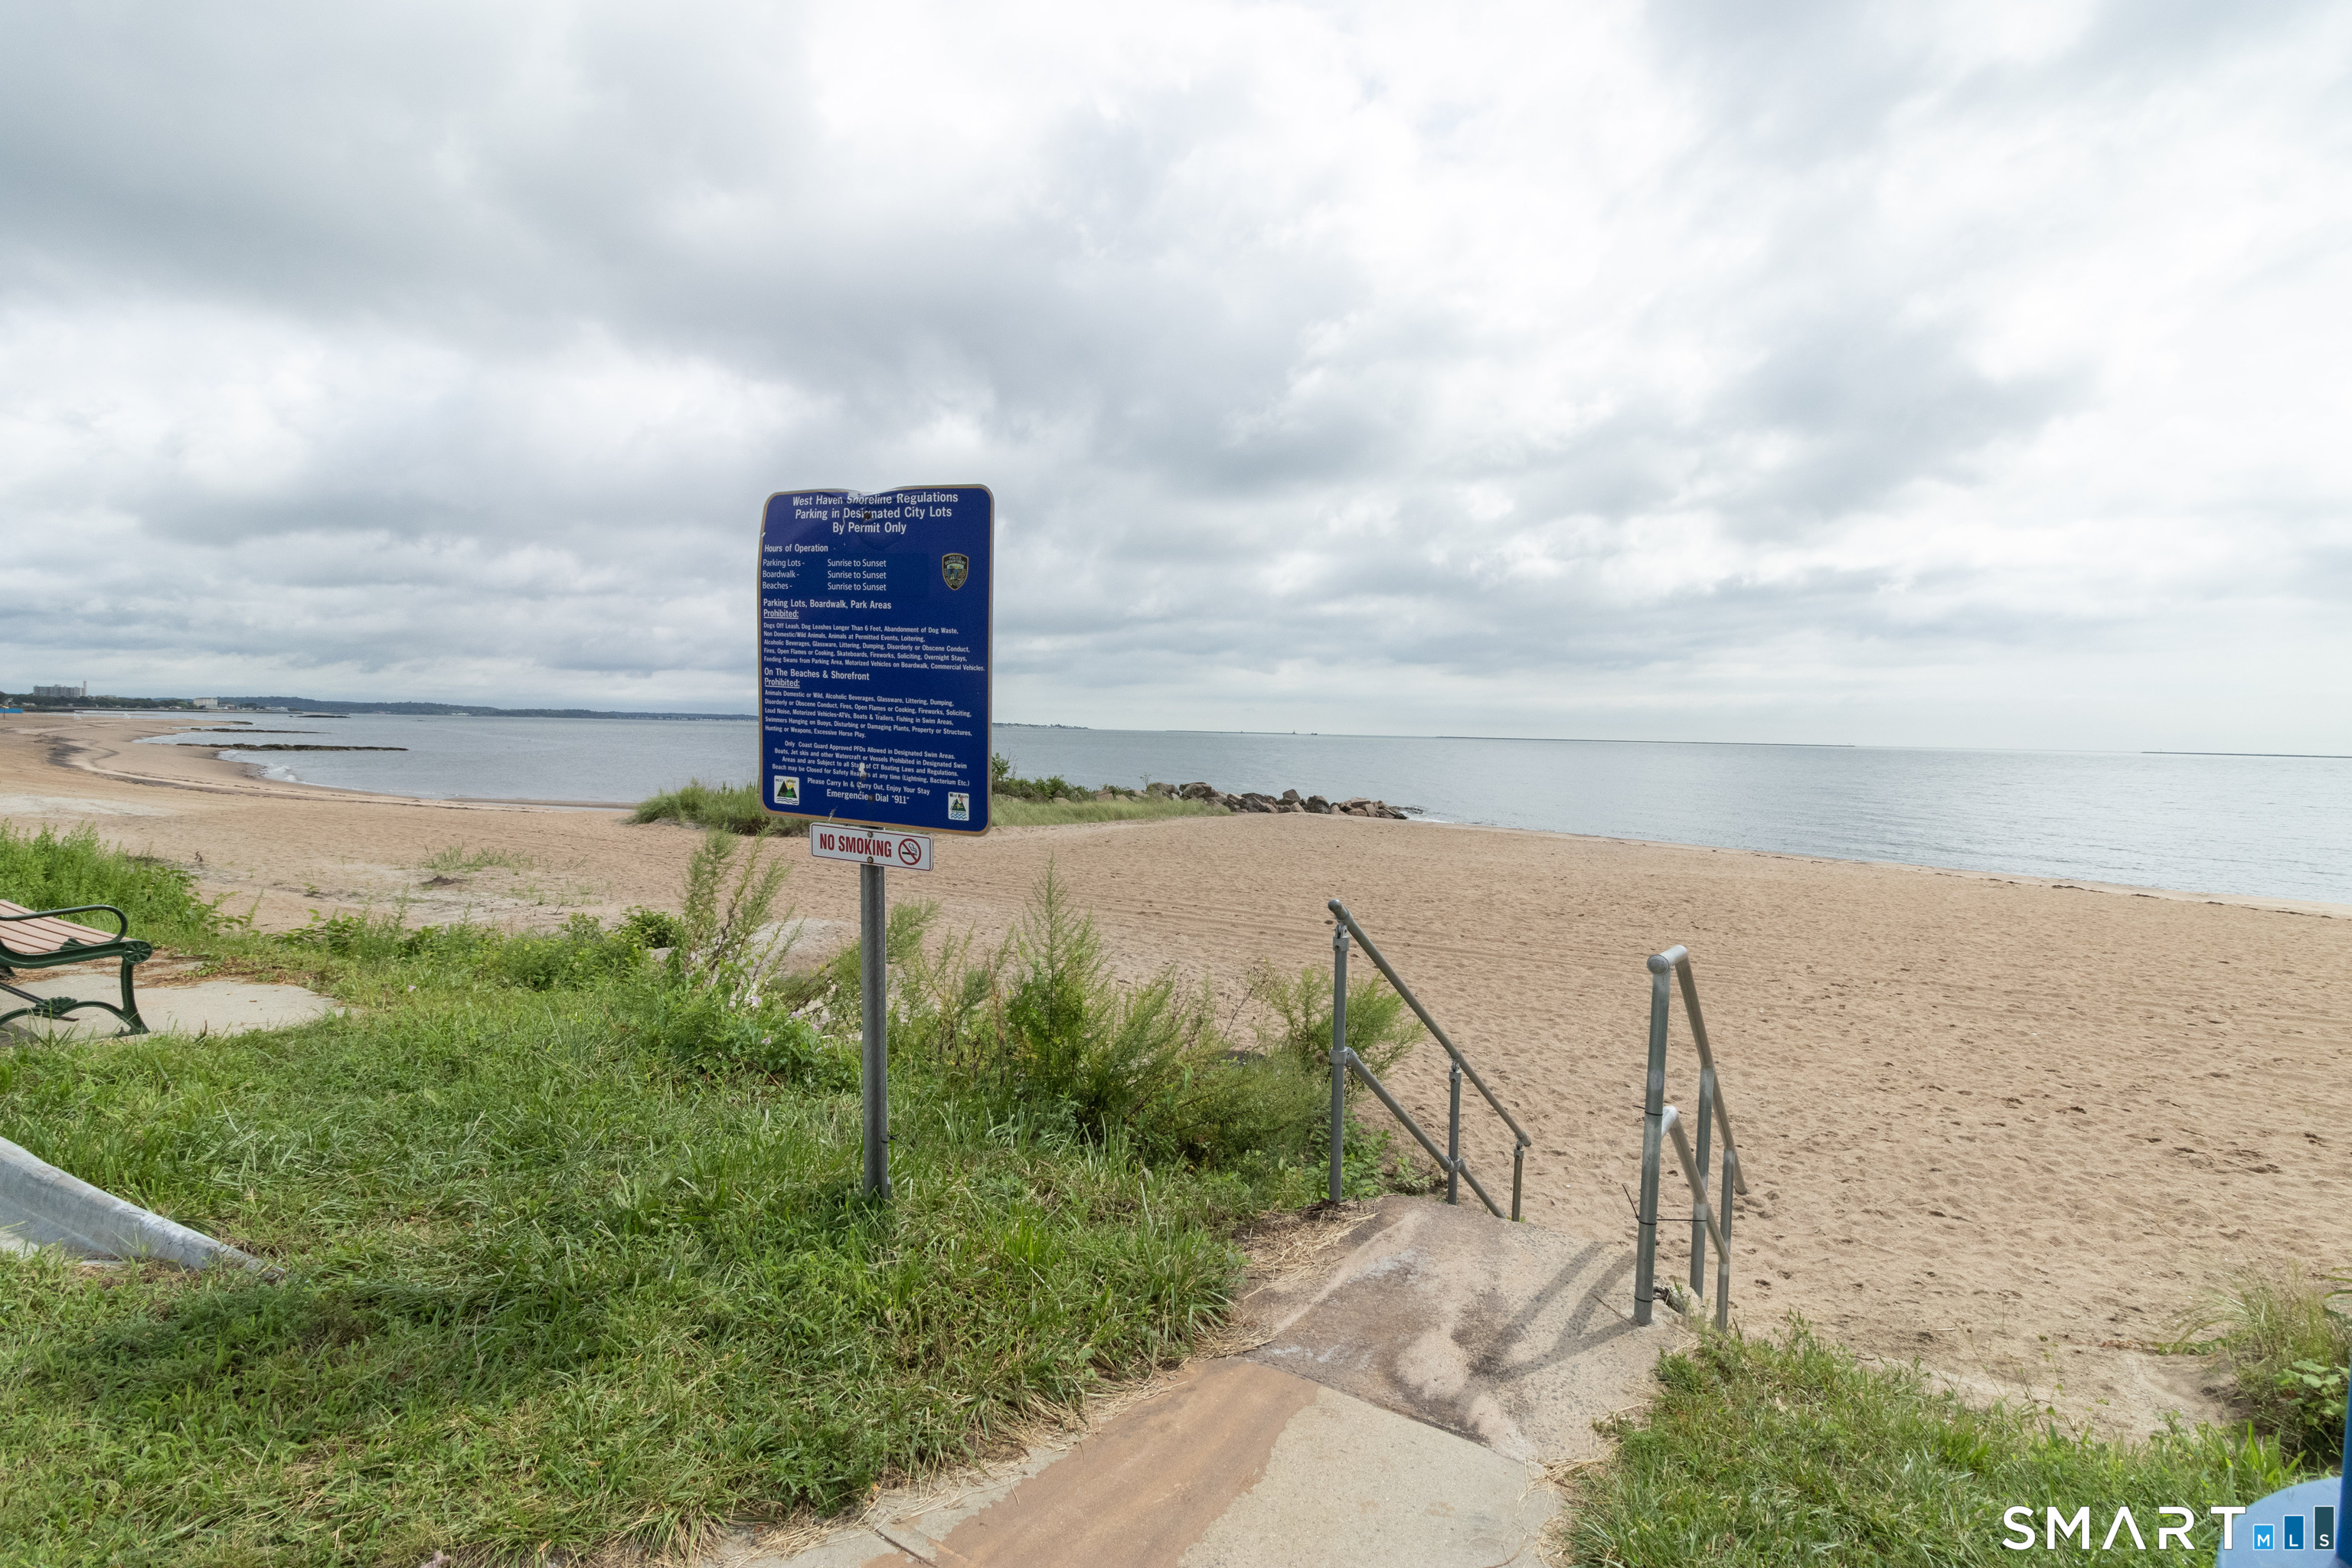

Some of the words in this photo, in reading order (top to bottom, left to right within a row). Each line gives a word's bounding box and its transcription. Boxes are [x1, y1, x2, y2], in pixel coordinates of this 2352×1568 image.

[793, 496, 813, 506] West
[816, 495, 843, 505] Haven
[897, 492, 958, 505] Regulations
[795, 508, 828, 521] Parking
[831, 508, 840, 518] in
[904, 507, 925, 519] City
[930, 507, 952, 517] Lots
[833, 522, 845, 535] By
[848, 523, 880, 533] Permit
[884, 523, 906, 535] Only
[795, 545, 828, 554] Operation
[763, 559, 786, 568] Parking
[763, 599, 789, 609] Parking
[791, 599, 808, 609] Lots,
[810, 599, 848, 609] Boardwalk,
[851, 600, 867, 609] Park
[870, 601, 891, 609] Areas
[763, 609, 799, 618] Prohibited:
[764, 668, 773, 676] On
[776, 668, 788, 677] The
[790, 669, 820, 678] Beaches
[822, 670, 828, 678] &
[831, 671, 870, 680] Shorefront
[765, 678, 800, 687] Prohibited:
[765, 698, 788, 707] Disorderly
[895, 706, 916, 714] Cooking,
[918, 707, 945, 716] Fireworks,
[946, 709, 972, 718] Soliciting,
[765, 725, 782, 733] Hunting
[790, 727, 812, 735] Weapons,
[854, 730, 866, 739] Play.
[834, 721, 859, 730] Disturbing
[867, 723, 892, 732] Damaging
[912, 726, 934, 734] Property
[943, 728, 972, 737] Structures,
[829, 744, 852, 753] Approved
[894, 748, 923, 758] Designated
[890, 756, 915, 765] Prohibited
[923, 759, 952, 769] Designated
[826, 779, 841, 789] Carry
[874, 783, 884, 792] Out,
[887, 784, 901, 793] Enjoy
[917, 786, 930, 796] Stay
[827, 789, 870, 802] Emergencie
[875, 793, 889, 802] Dial
[819, 833, 835, 851] NO
[838, 836, 892, 858] SMOKING
